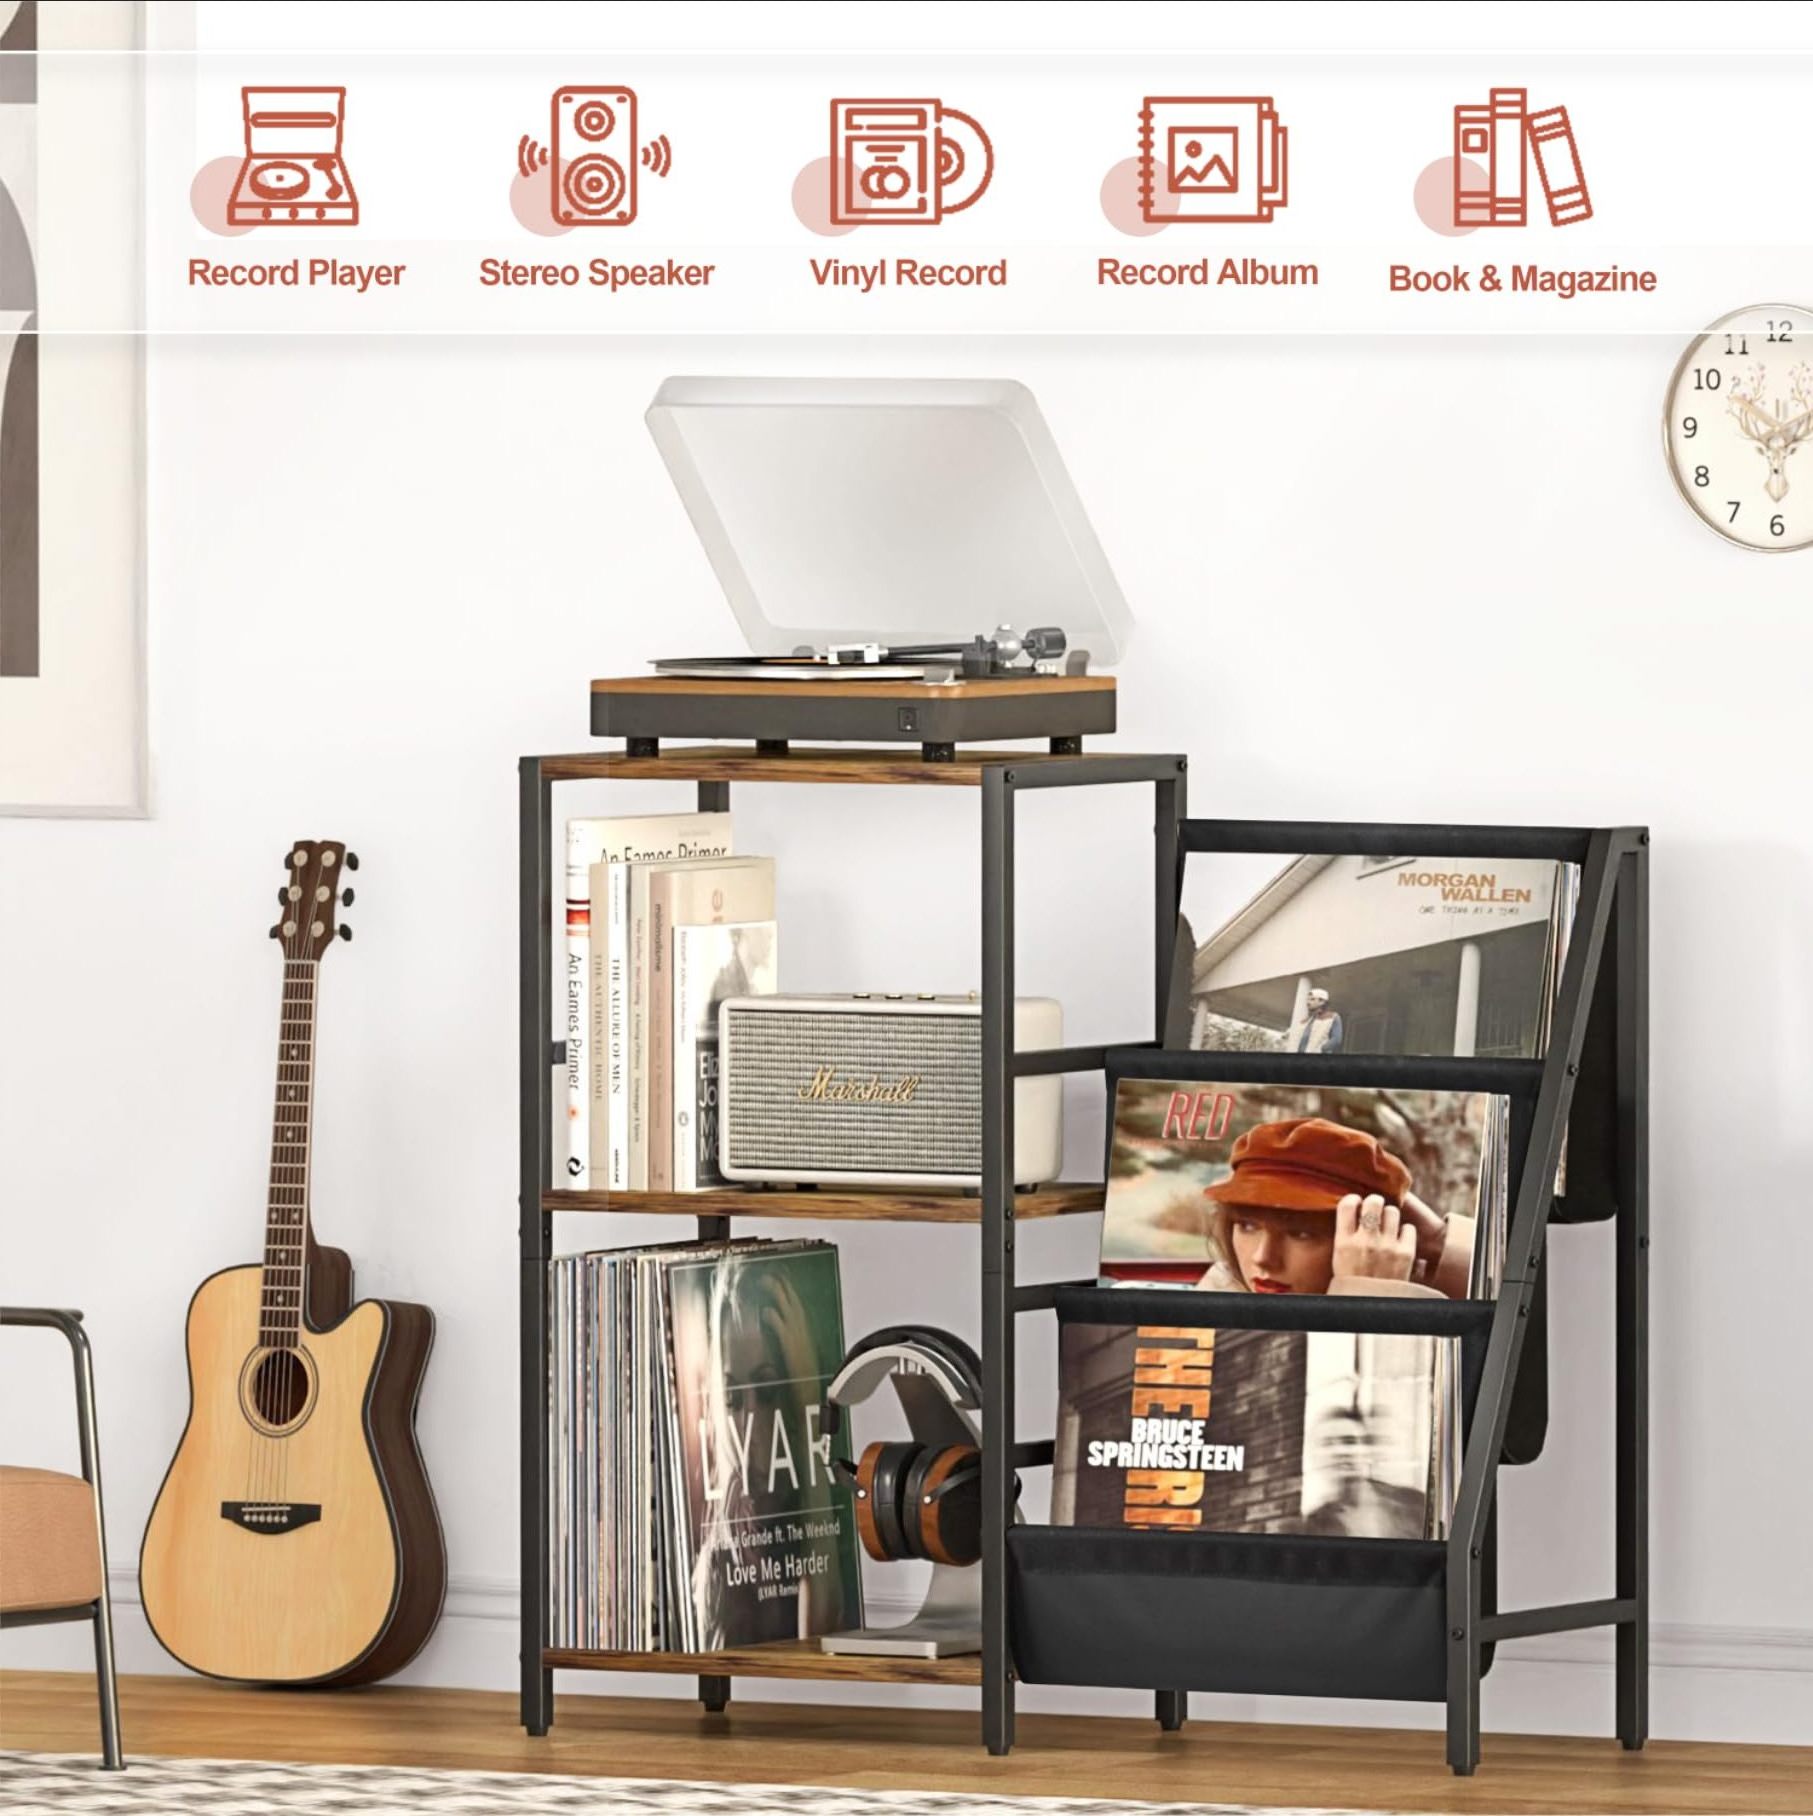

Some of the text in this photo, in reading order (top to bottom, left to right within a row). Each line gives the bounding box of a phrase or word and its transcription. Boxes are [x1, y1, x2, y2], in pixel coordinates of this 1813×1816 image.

[1724, 333, 1749, 355] 11
[1766, 320, 1793, 342] 12
[1694, 368, 1721, 390] 10
[1682, 416, 1698, 439] 9
[1694, 465, 1710, 488] 8
[1727, 501, 1741, 523] 7
[1769, 514, 1785, 537] 6
[1398, 873, 1496, 888] MORGAN
[1441, 887, 1532, 903] WALLEN
[567, 953, 583, 1091] An Eames Primer
[594, 955, 603, 1102] THE AUTHENTIC HOME
[611, 959, 621, 1095] THE ALLURE OF MEN
[699, 1079, 719, 1108] Jo
[798, 1065, 932, 1102] Marshall
[1162, 1091, 1236, 1140] RED
[1131, 1418, 1206, 1446] BRUCE
[699, 1404, 837, 1501] LYAR
[1087, 1440, 1245, 1472] SPRINGSTEEN
[1123, 1469, 1205, 1531] RI
[741, 1527, 773, 1548] Grande
[775, 1525, 786, 1544] ft.
[786, 1523, 803, 1542] The
[805, 1517, 840, 1539] Weeknd
[725, 1549, 830, 1587] Love Me Harder
